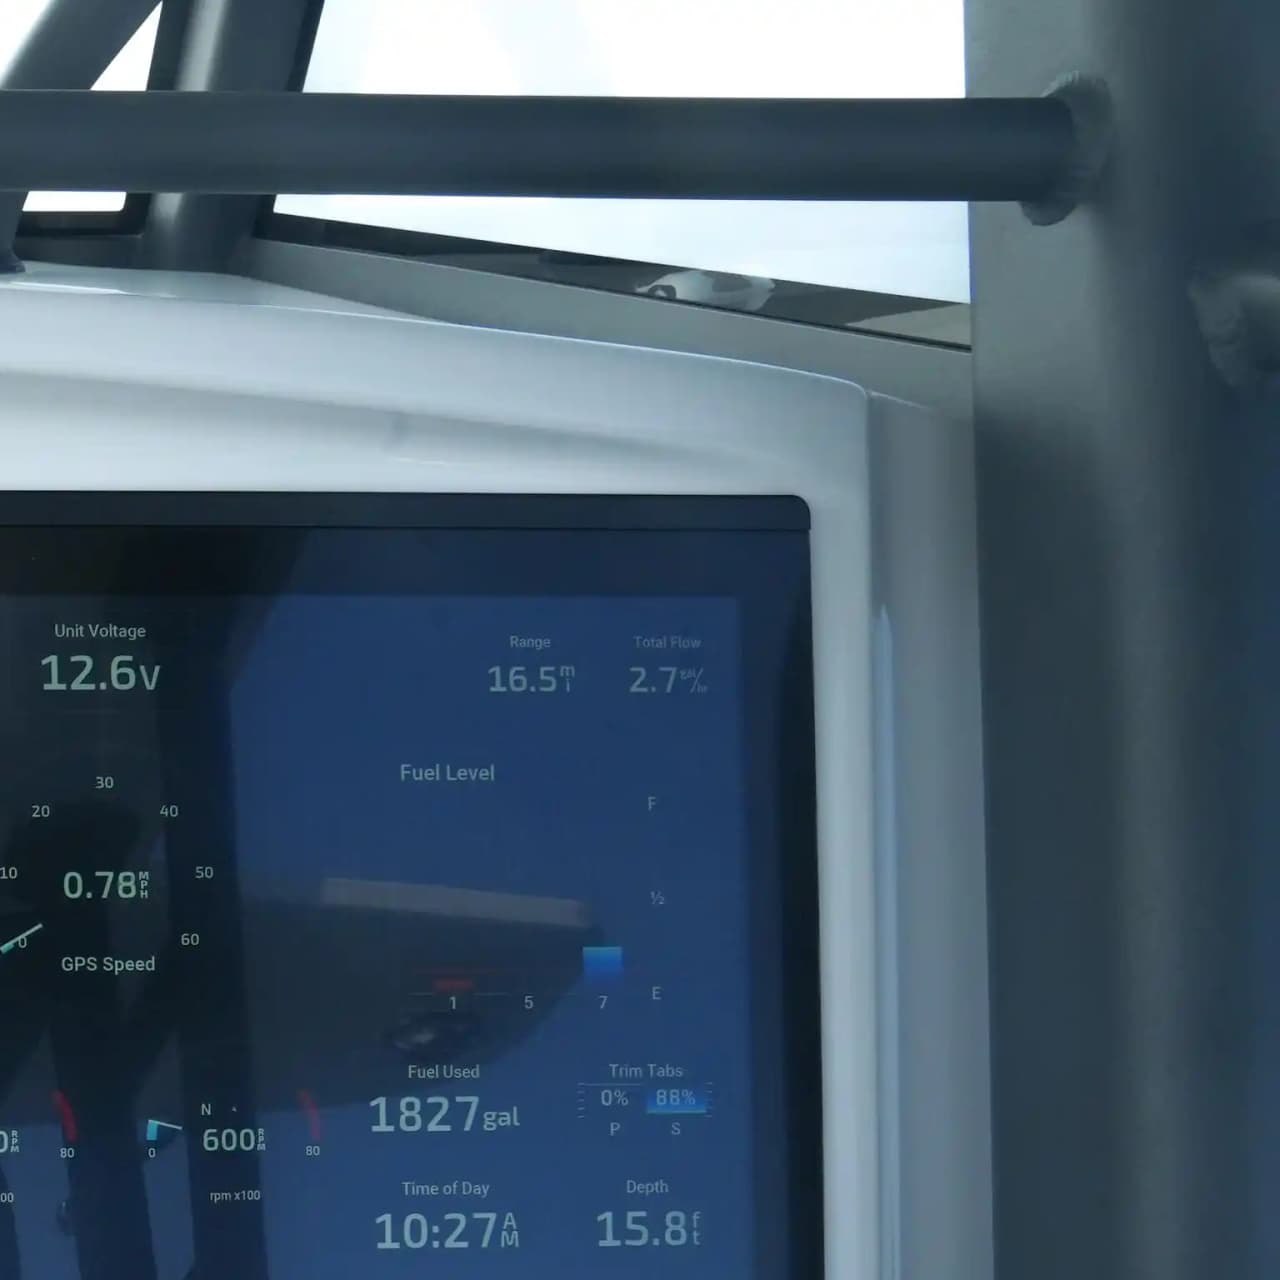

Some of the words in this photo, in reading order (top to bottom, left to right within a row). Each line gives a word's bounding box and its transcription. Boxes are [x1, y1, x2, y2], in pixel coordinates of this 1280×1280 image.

[54, 623, 85, 639] Unit
[88, 623, 147, 641] Voltage
[509, 635, 552, 651] Range
[633, 636, 667, 649] Total
[400, 762, 440, 781] Fuel
[446, 762, 496, 781] Level
[95, 776, 115, 790] 30
[31, 805, 51, 818] 20
[159, 805, 179, 818] 40
[0, 866, 19, 880] 10
[194, 866, 215, 880] 50
[180, 932, 200, 946] 60
[60, 956, 98, 972] GPS
[102, 956, 157, 975] Speed
[407, 1064, 441, 1079] Fuel
[444, 1064, 481, 1079] Used
[608, 1063, 643, 1078] Trim
[647, 1063, 684, 1078] Tabs
[201, 1103, 212, 1116] N
[59, 1146, 75, 1159] 80
[305, 1145, 320, 1157] 80
[402, 1181, 440, 1196] Time
[442, 1181, 457, 1196] of
[460, 1181, 490, 1199] Day
[626, 1179, 670, 1197] Depth
[209, 1192, 232, 1203] rpm
[234, 1189, 261, 1202] x100
